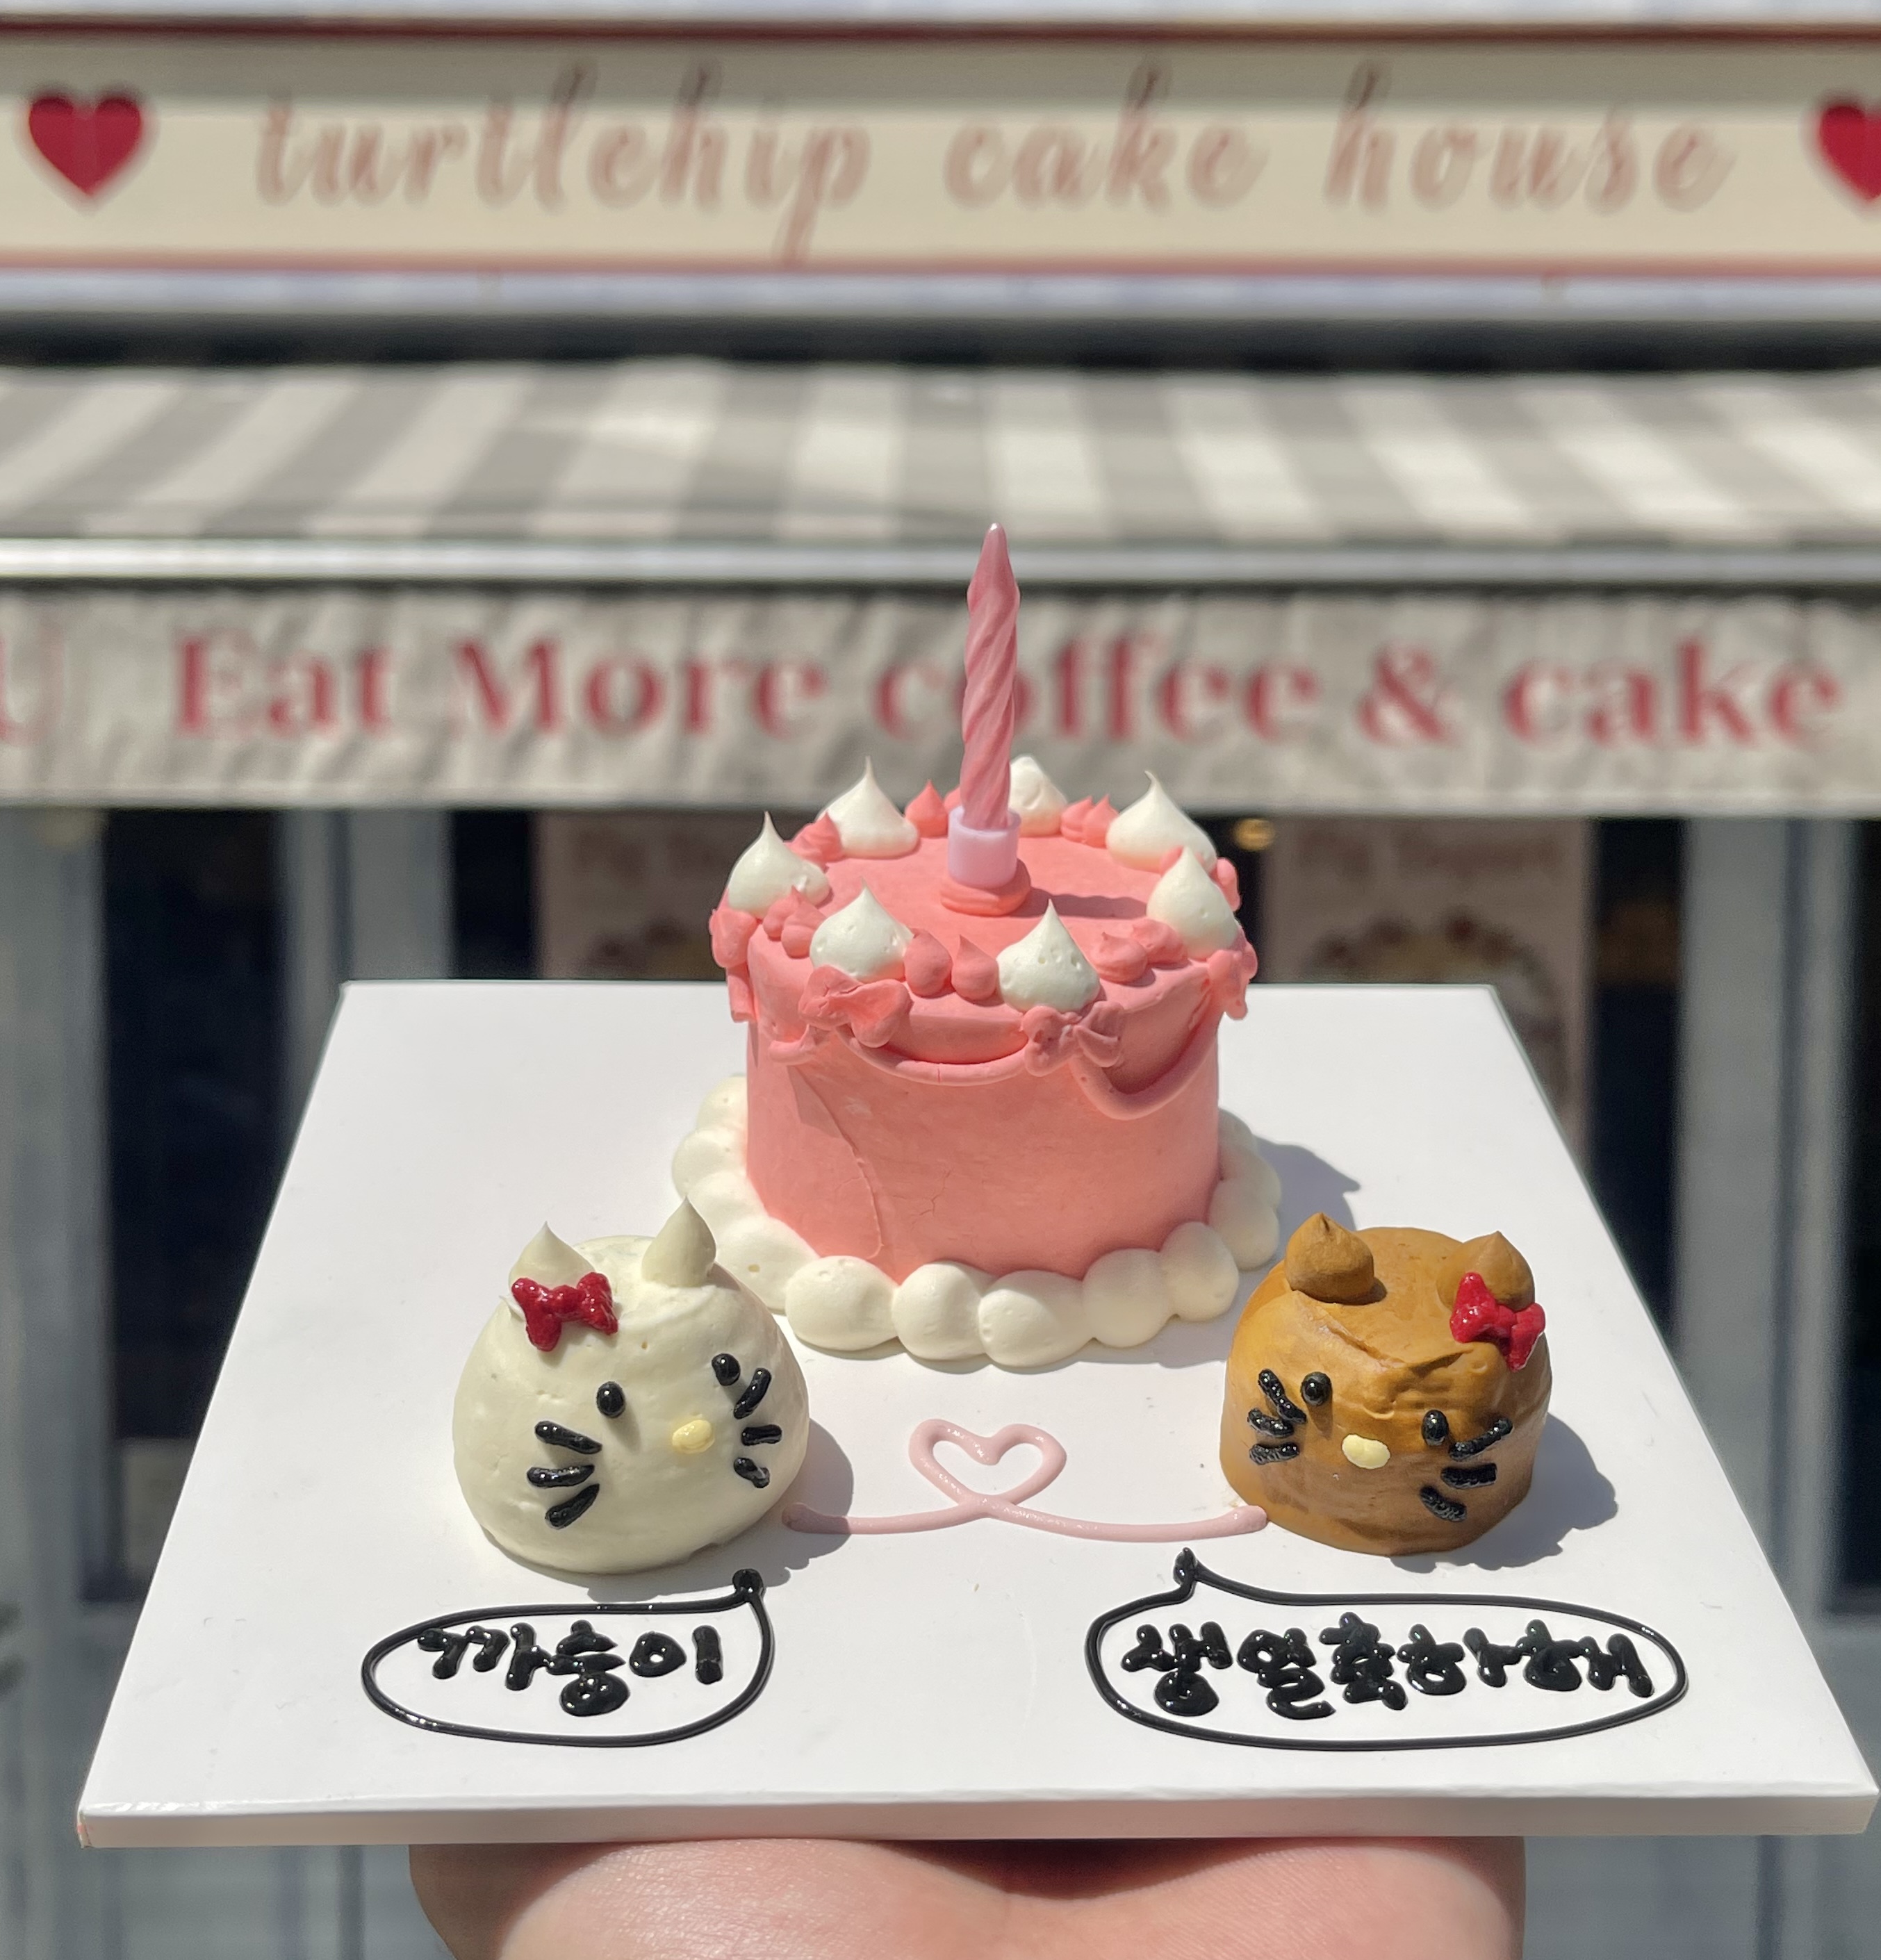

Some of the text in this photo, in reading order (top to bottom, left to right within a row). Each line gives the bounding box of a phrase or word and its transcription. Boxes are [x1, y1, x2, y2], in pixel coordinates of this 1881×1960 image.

[252, 57, 1736, 266] turtlehip cake house
[174, 630, 391, 738] Eat
[450, 634, 827, 738] More
[1356, 641, 1461, 746] &
[1502, 635, 1841, 746] cake
